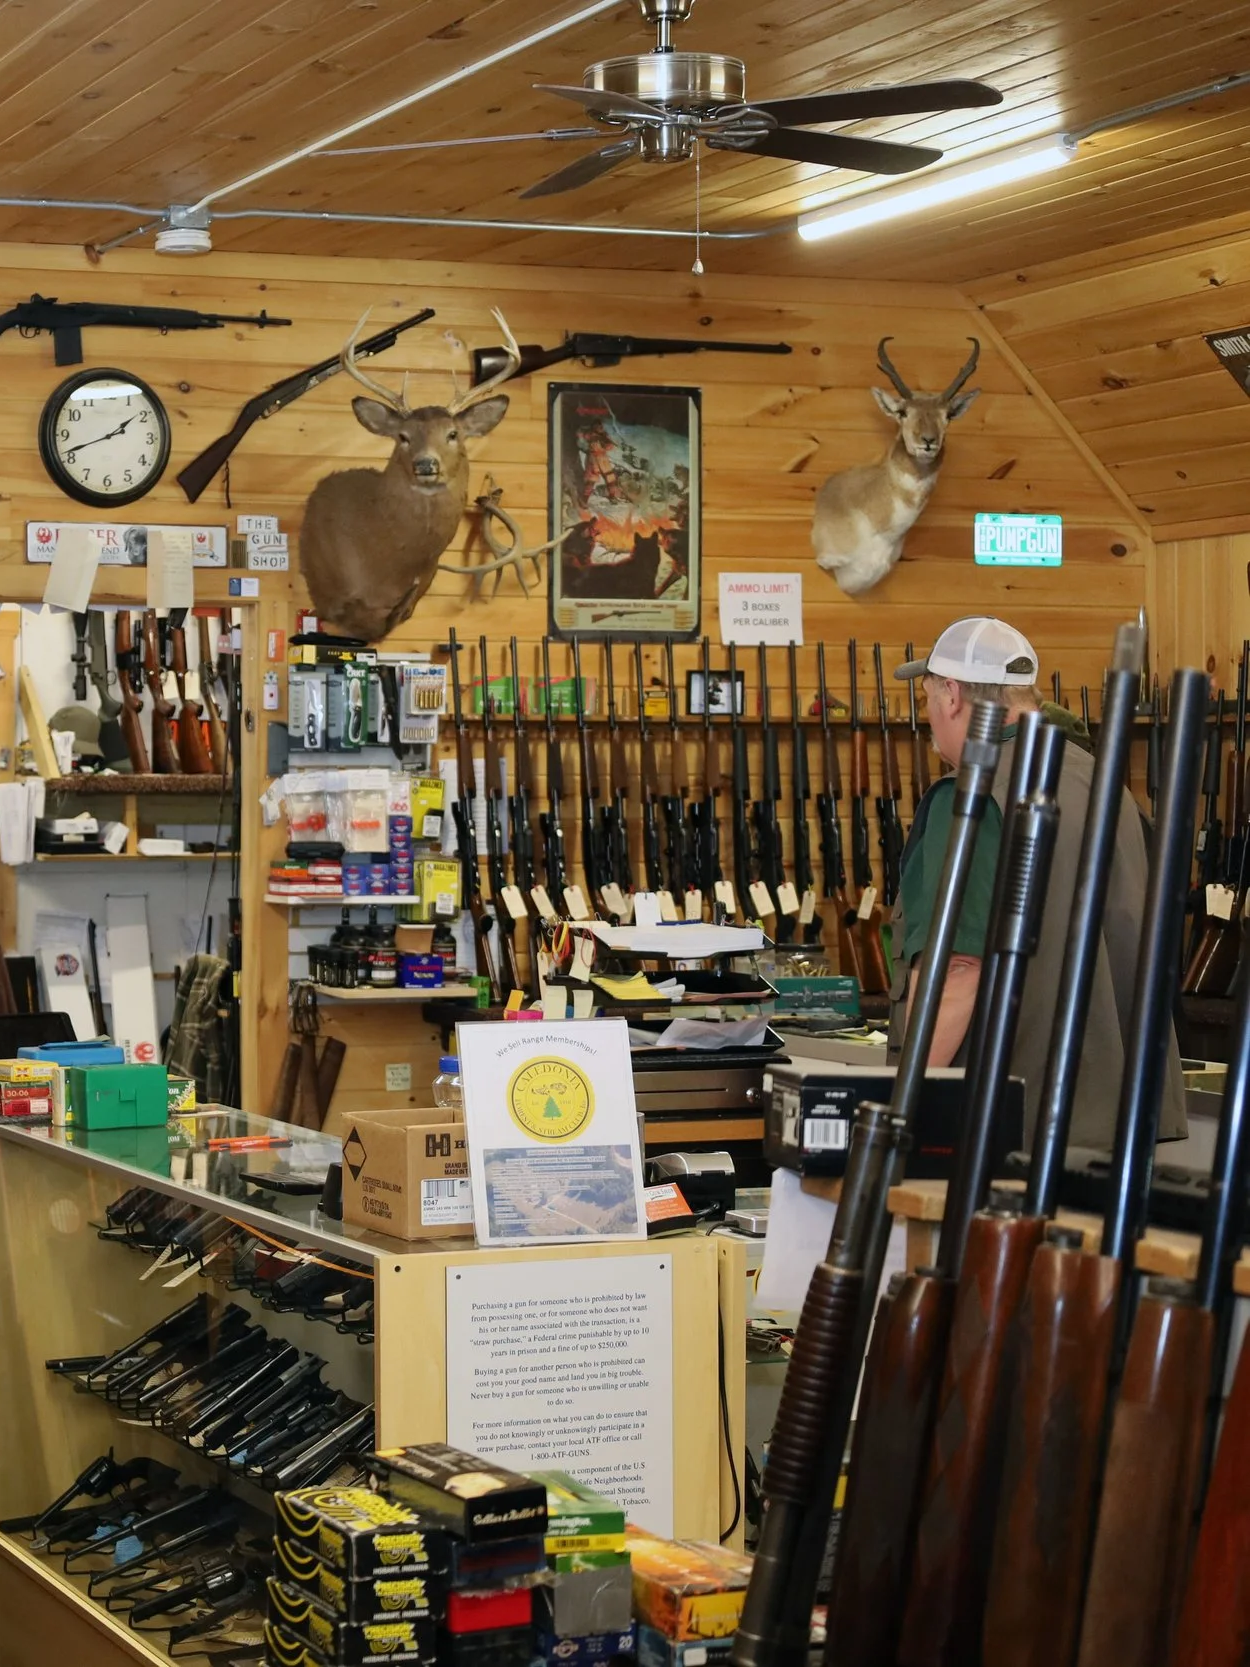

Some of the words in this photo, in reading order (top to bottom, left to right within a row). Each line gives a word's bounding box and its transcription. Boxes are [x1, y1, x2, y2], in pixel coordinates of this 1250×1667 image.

[1213, 335, 1250, 357] SMITH
[68, 409, 81, 421] 10
[139, 410, 147, 423] 2
[61, 429, 69, 442] 9
[146, 432, 154, 445] 3
[67, 451, 76, 464] 8
[138, 454, 147, 466] 4
[82, 468, 91, 480] 7
[124, 469, 132, 482] 5
[103, 475, 112, 487] 6
[246, 518, 272, 530] THE
[251, 534, 282, 545] GUN
[986, 526, 1058, 553] PUMPGUN
[252, 556, 286, 568] SHOP
[727, 584, 761, 594] AMMO
[763, 583, 794, 594] LIMIT:
[742, 601, 749, 611] 3
[752, 603, 781, 611] BOXES
[733, 618, 751, 626] PER
[752, 618, 790, 626] CALIBER
[496, 1047, 508, 1057] We
[522, 1036, 544, 1046] Range
[545, 1035, 598, 1056] Memberships!
[517, 1064, 581, 1092] CALEDONIA
[472, 1301, 507, 1310] Purchasing
[514, 1301, 526, 1309] gun
[528, 1298, 537, 1306] for
[569, 1296, 583, 1304] who
[591, 1293, 623, 1305] prohibited
[624, 1292, 632, 1302] by
[634, 1292, 646, 1300] law
[470, 1314, 487, 1322] from
[488, 1313, 522, 1323] possessing
[548, 1309, 557, 1317] for
[588, 1306, 602, 1314] who
[603, 1306, 618, 1314] does
[632, 1304, 648, 1312] want
[478, 1326, 488, 1334] his
[498, 1324, 509, 1332] her
[529, 1320, 562, 1330] associated
[564, 1319, 578, 1328] with
[579, 1319, 590, 1327] the
[590, 1318, 627, 1326] transaction,
[533, 1332, 557, 1342] Federal
[578, 1329, 612, 1341] punishable
[613, 1328, 621, 1338] by
[623, 1330, 632, 1338] up
[641, 1326, 650, 1334] 10
[490, 1350, 508, 1358] years
[517, 1347, 537, 1356] prison
[538, 1344, 550, 1353] and
[557, 1344, 570, 1352] fine
[571, 1343, 578, 1351] of
[474, 1368, 498, 1377] Buying
[504, 1368, 517, 1376] gun
[518, 1365, 528, 1373] for
[529, 1363, 553, 1372] another
[555, 1364, 576, 1372] person
[578, 1360, 592, 1369] who
[600, 1357, 632, 1369] prohibited
[490, 1380, 503, 1388] you
[504, 1379, 519, 1388] your
[520, 1375, 537, 1386] good
[557, 1373, 569, 1382] and
[570, 1372, 584, 1381] land
[586, 1374, 598, 1382] you
[607, 1370, 618, 1380] big
[470, 1391, 490, 1399] Never
[491, 1390, 504, 1400] buy
[510, 1390, 523, 1399] gun
[524, 1388, 534, 1396] for
[565, 1384, 579, 1392] who
[588, 1382, 618, 1391] unwilling
[628, 1379, 650, 1388] unable
[554, 1397, 563, 1405] do
[472, 1421, 484, 1429] For
[503, 1418, 541, 1427] information
[552, 1415, 568, 1423] what
[569, 1416, 582, 1424] you
[595, 1412, 604, 1420] do
[635, 1409, 648, 1417] that
[618, 1634, 633, 1649] 20
